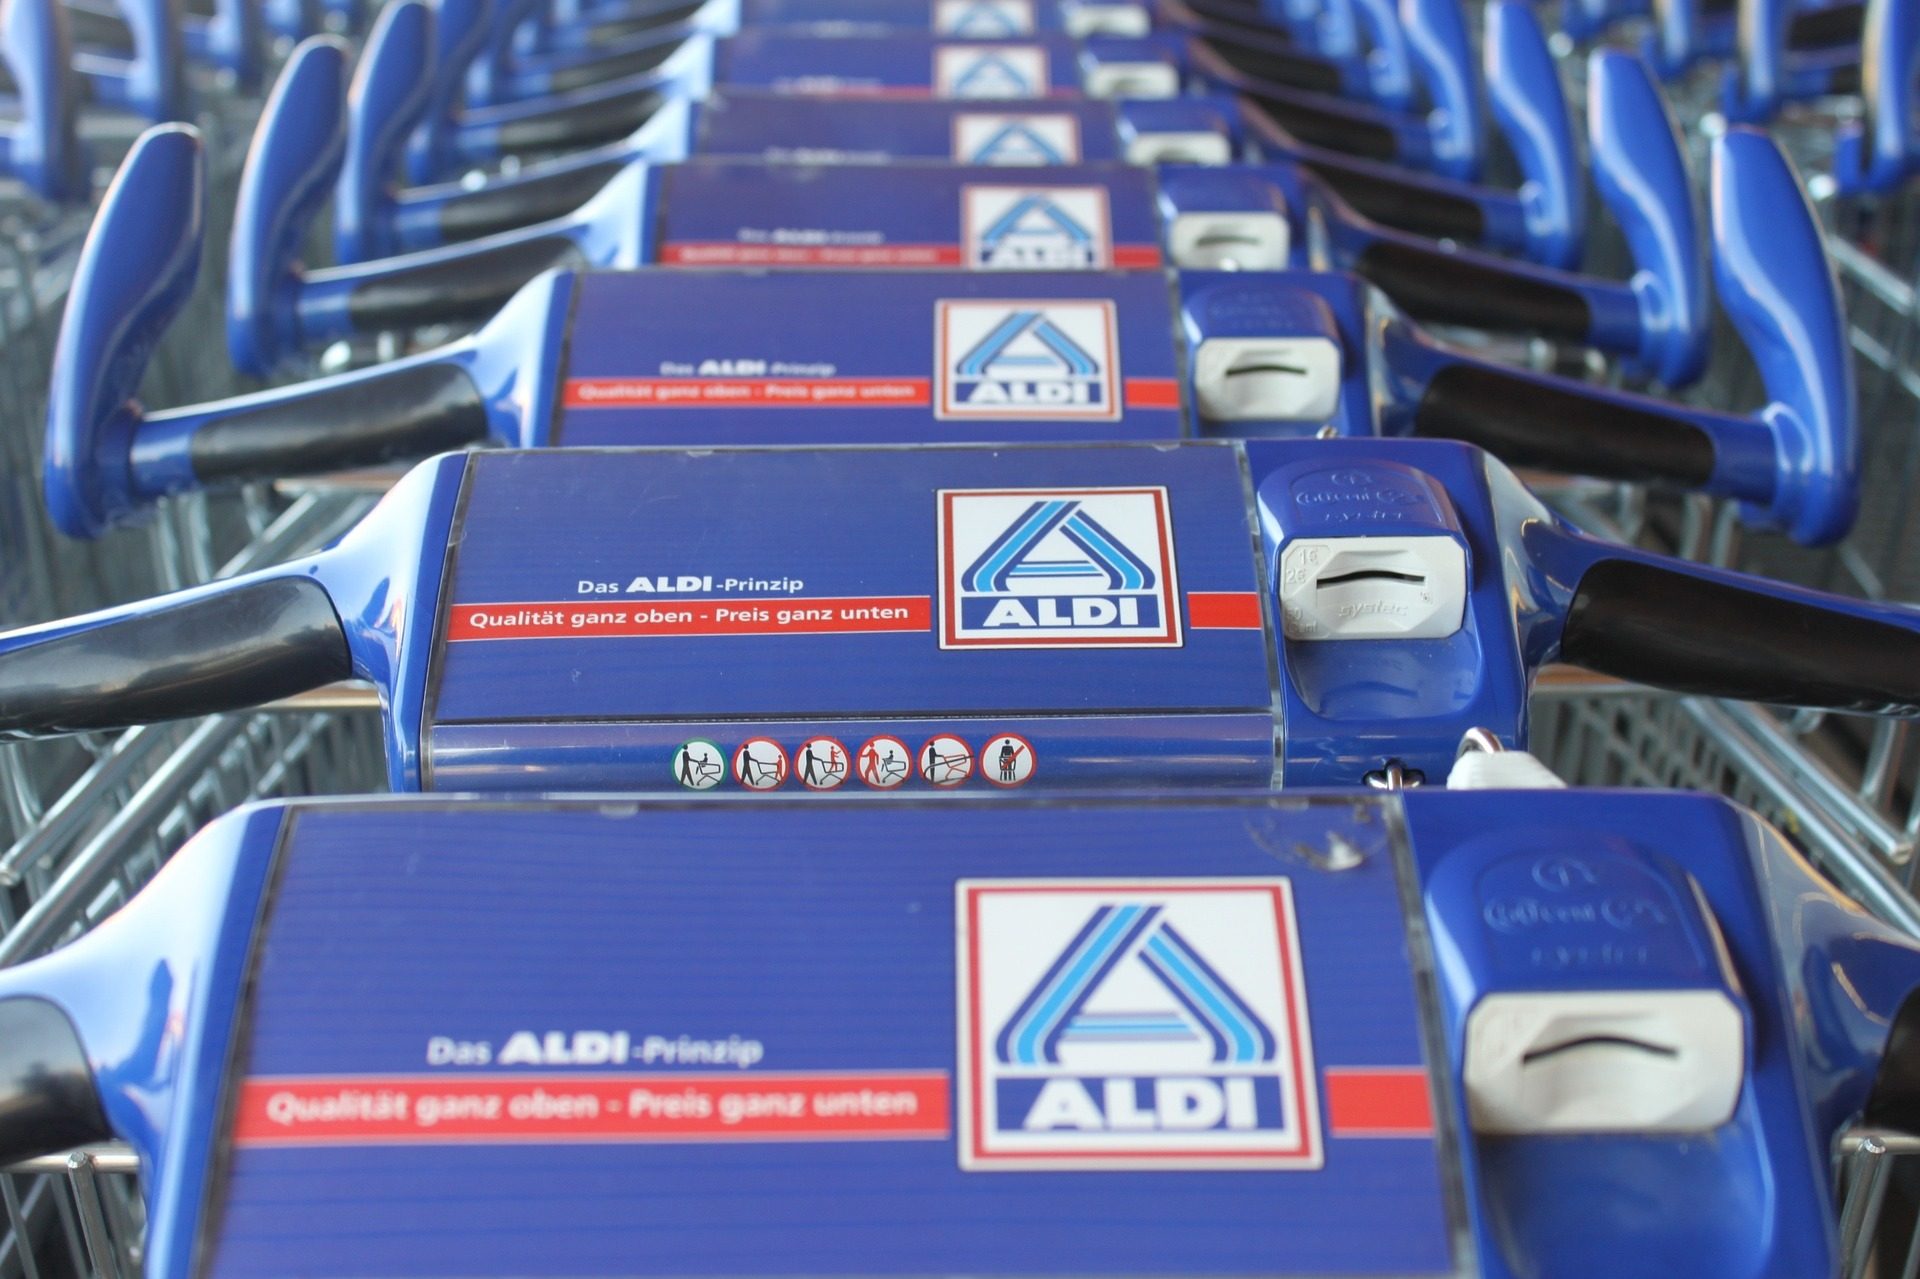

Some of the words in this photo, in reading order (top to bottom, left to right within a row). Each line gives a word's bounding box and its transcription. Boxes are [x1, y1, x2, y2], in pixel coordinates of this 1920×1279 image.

[969, 381, 1089, 404] ALDI
[578, 580, 619, 594] Das
[469, 610, 564, 628] Qualität
[571, 612, 627, 628] ganz
[634, 609, 693, 623] oben
[716, 607, 770, 622] Preis
[776, 609, 833, 624] ganz
[841, 606, 908, 620] unten
[982, 597, 1139, 627] ALDI
[427, 1036, 492, 1066] Das
[267, 1089, 408, 1125] Qualität
[417, 1097, 501, 1126] ganz
[508, 1089, 599, 1119] oben
[629, 1088, 711, 1118] Preis
[719, 1096, 803, 1125] ganz
[811, 1088, 918, 1117] unten
[1023, 1077, 1258, 1130] ALDI
